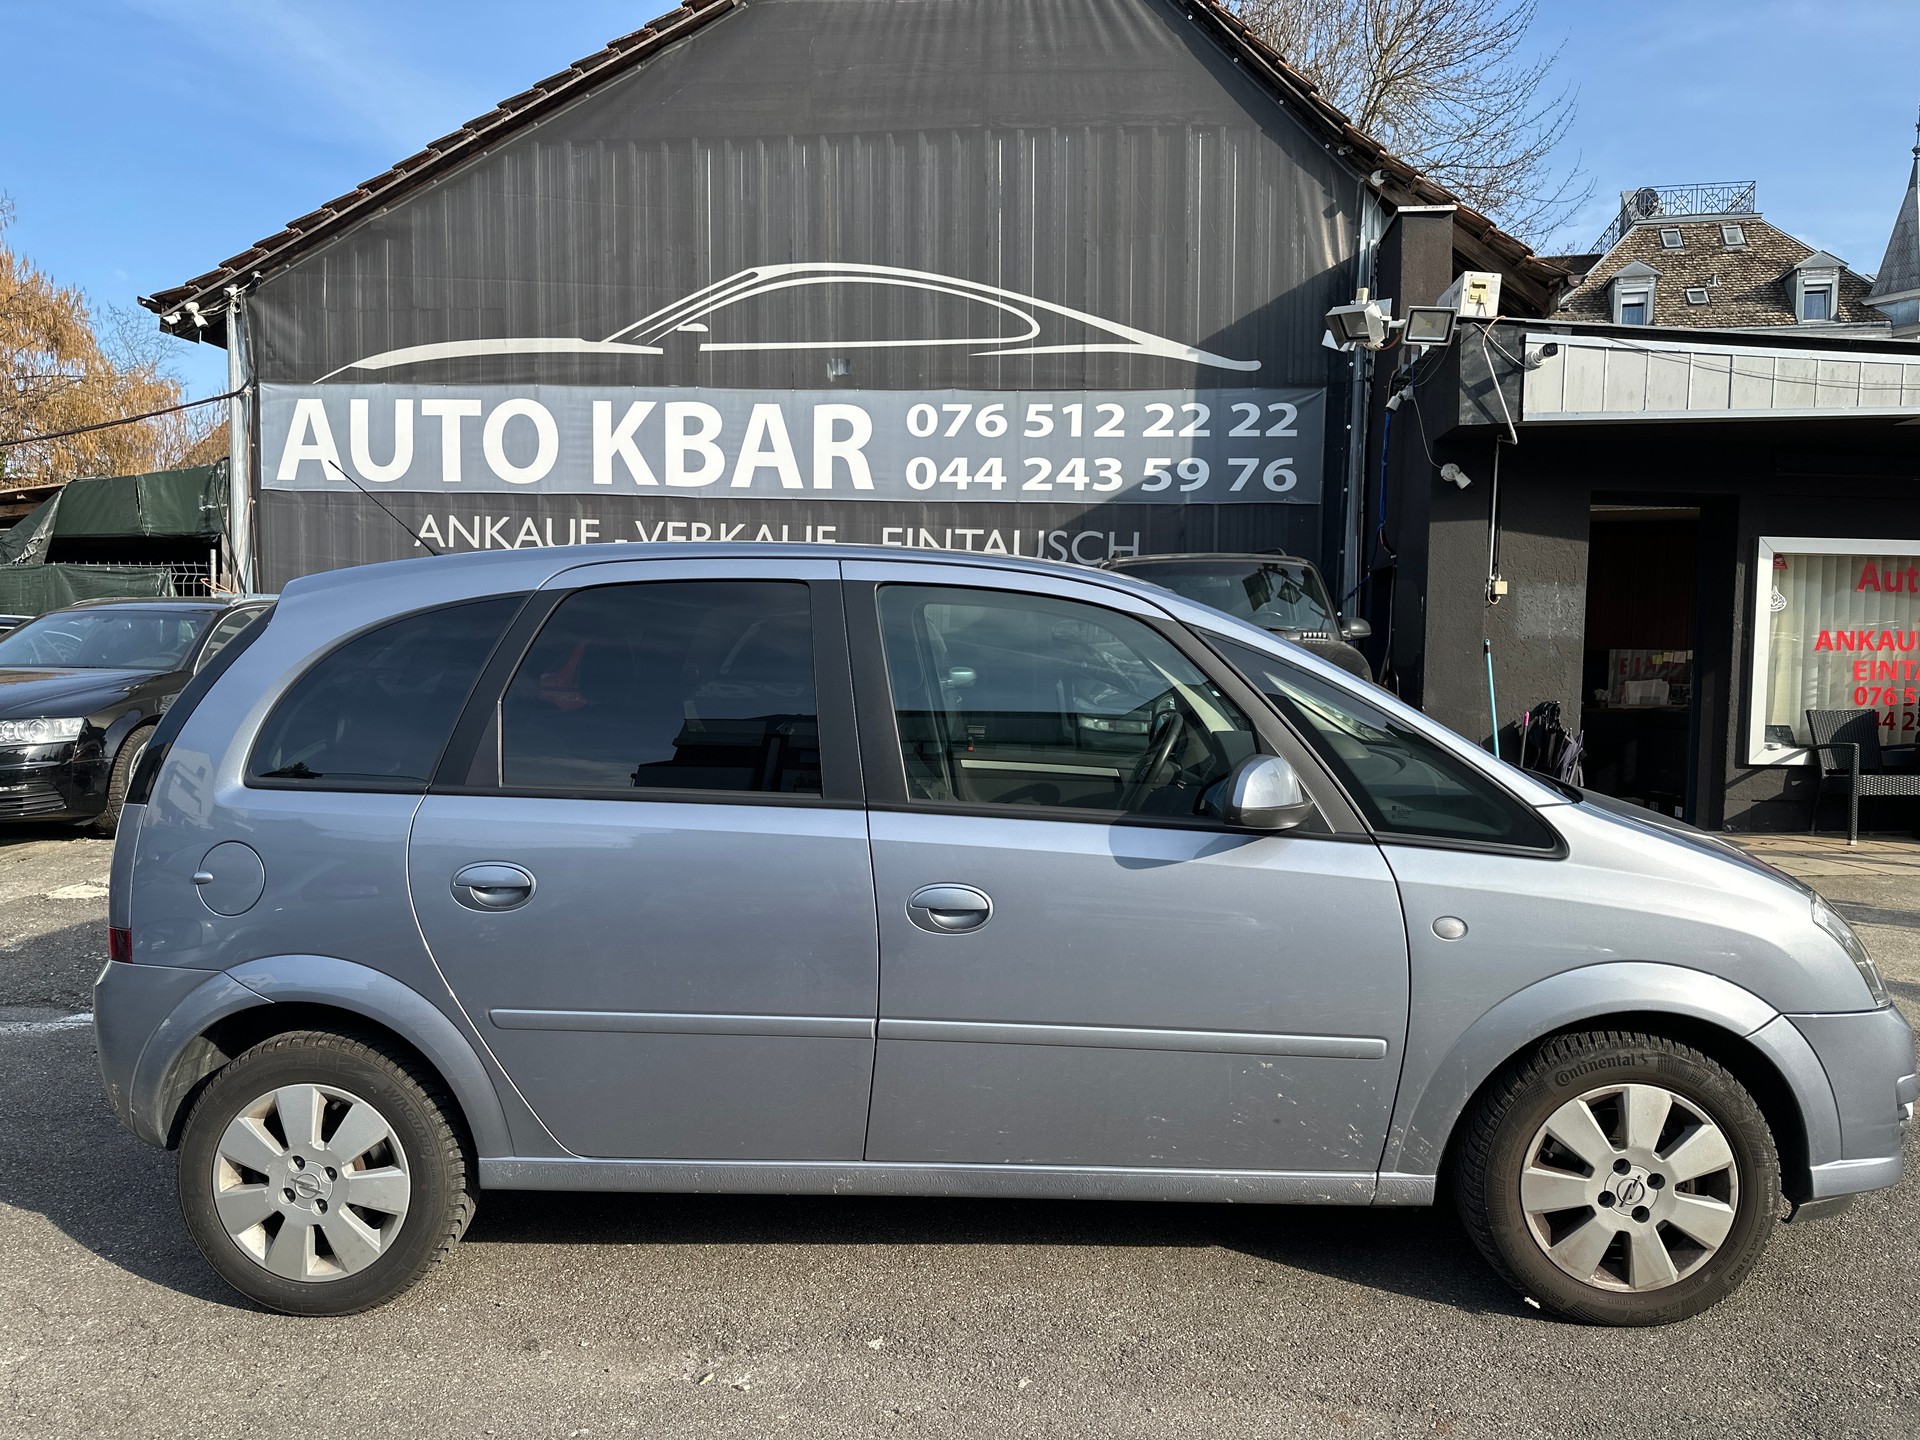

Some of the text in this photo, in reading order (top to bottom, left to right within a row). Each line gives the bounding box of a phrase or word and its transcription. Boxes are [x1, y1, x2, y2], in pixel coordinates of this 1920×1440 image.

[906, 403, 1298, 438] 076 512 22 22
[276, 398, 875, 490] AUTO KBAR
[905, 456, 1298, 492] 044 243 59 76
[1815, 630, 1920, 652] ANKAU
[1853, 686, 1897, 707] 076
[1554, 1053, 1636, 1087] Continental
